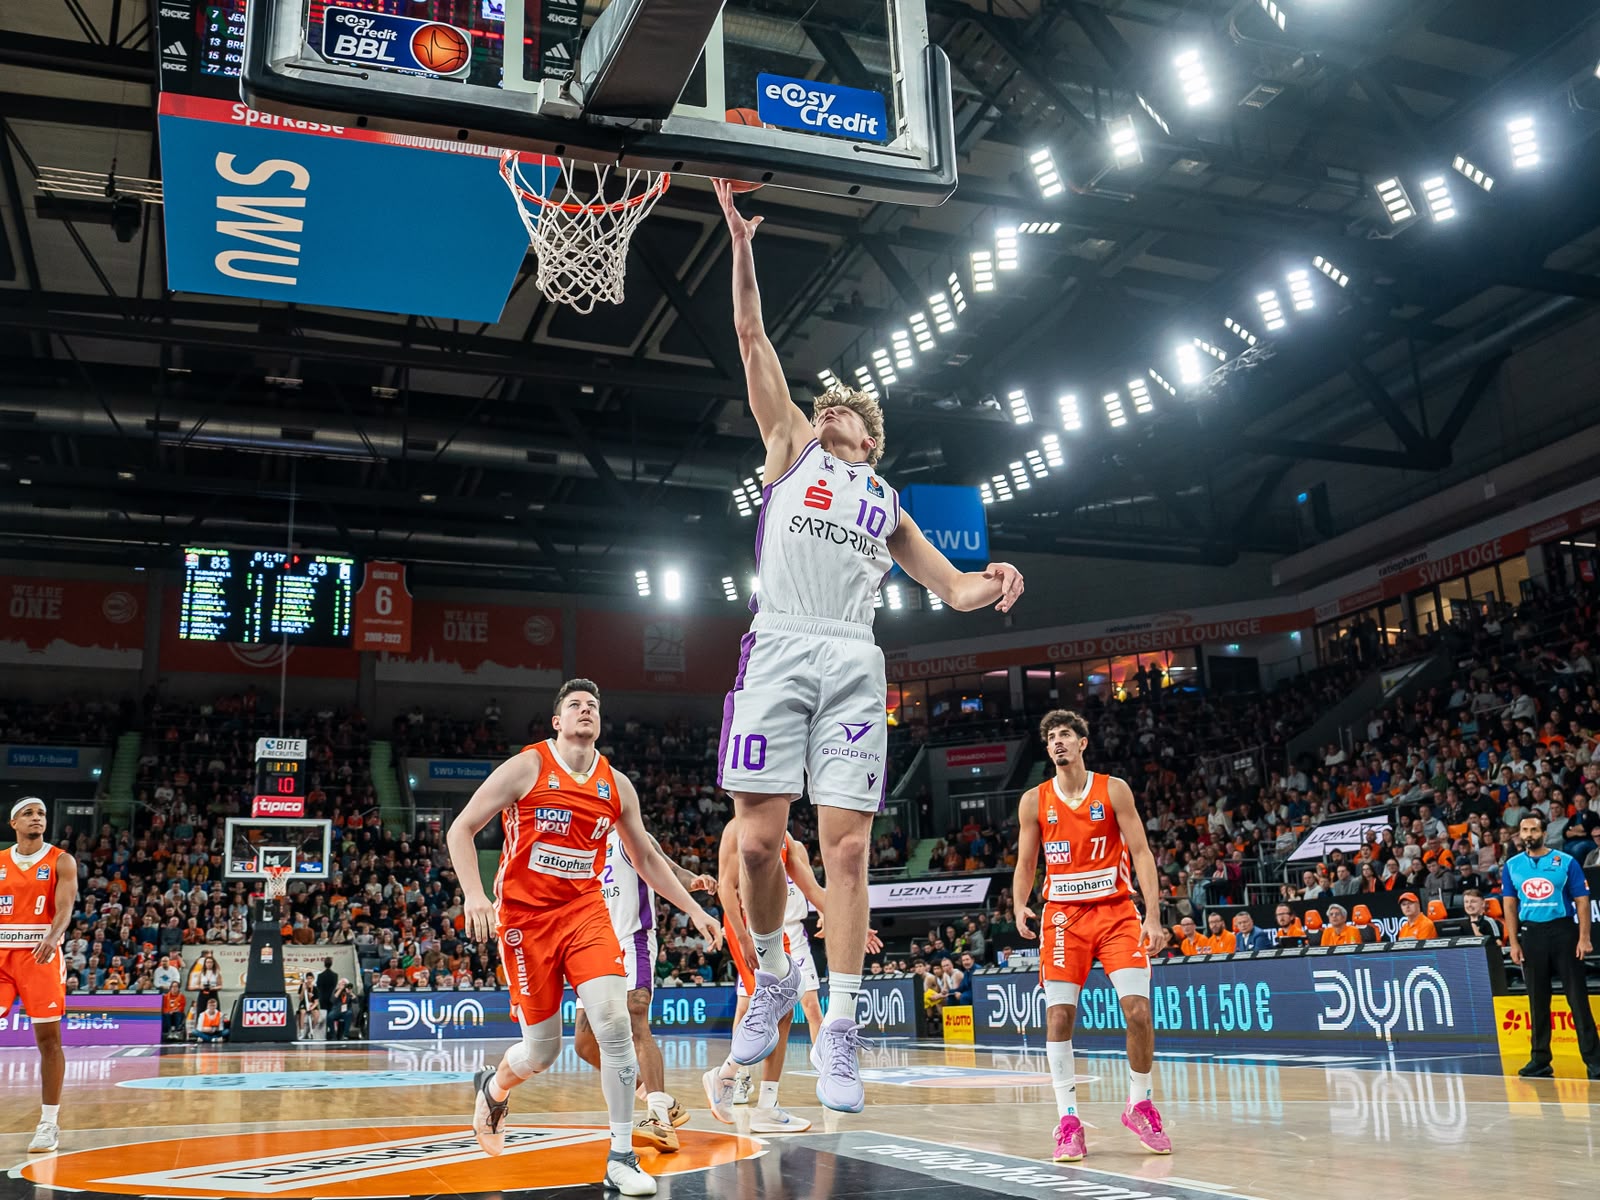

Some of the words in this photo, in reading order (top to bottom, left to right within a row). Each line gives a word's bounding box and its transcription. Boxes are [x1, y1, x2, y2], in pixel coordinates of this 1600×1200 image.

[211, 10, 219, 18] 7
[209, 37, 221, 46] 13
[353, 25, 398, 42] Credit
[208, 51, 219, 60] 15
[333, 34, 396, 62] BBL
[207, 64, 220, 73] 77
[799, 105, 878, 135] Credit
[214, 150, 311, 287] SWU
[856, 498, 887, 538] 10
[789, 515, 878, 560] SARTORIUS
[923, 529, 980, 551] SWU
[210, 556, 230, 570] 83
[308, 563, 328, 577] 53
[1418, 538, 1504, 586] SWU-LOGE
[9, 597, 62, 620] ONE
[375, 585, 393, 616] 6
[443, 623, 488, 642] ONE
[1047, 640, 1097, 660] GOLD
[1100, 631, 1177, 654] OCHSEN
[1181, 619, 1261, 644] LOUNGE
[908, 655, 977, 676] LOUNGE
[276, 740, 301, 751] BITE
[731, 733, 768, 771] 10
[259, 798, 302, 813] tipico
[536, 809, 572, 822] LIQUI
[536, 820, 570, 835] MOLY
[1090, 836, 1107, 860] 77
[889, 886, 933, 897] UZIN
[936, 883, 975, 894] UTZ
[1055, 878, 1113, 894] ratiopharm
[34, 895, 46, 915] 9
[1052, 926, 1066, 969] Allianz
[514, 947, 531, 996] Allianz
[246, 1000, 284, 1012] LIQUI
[693, 997, 707, 1025] €
[1154, 985, 1183, 1031] AB
[1255, 981, 1273, 1032] €
[245, 1012, 285, 1025] MOLY
[953, 1014, 971, 1027] LOTTO
